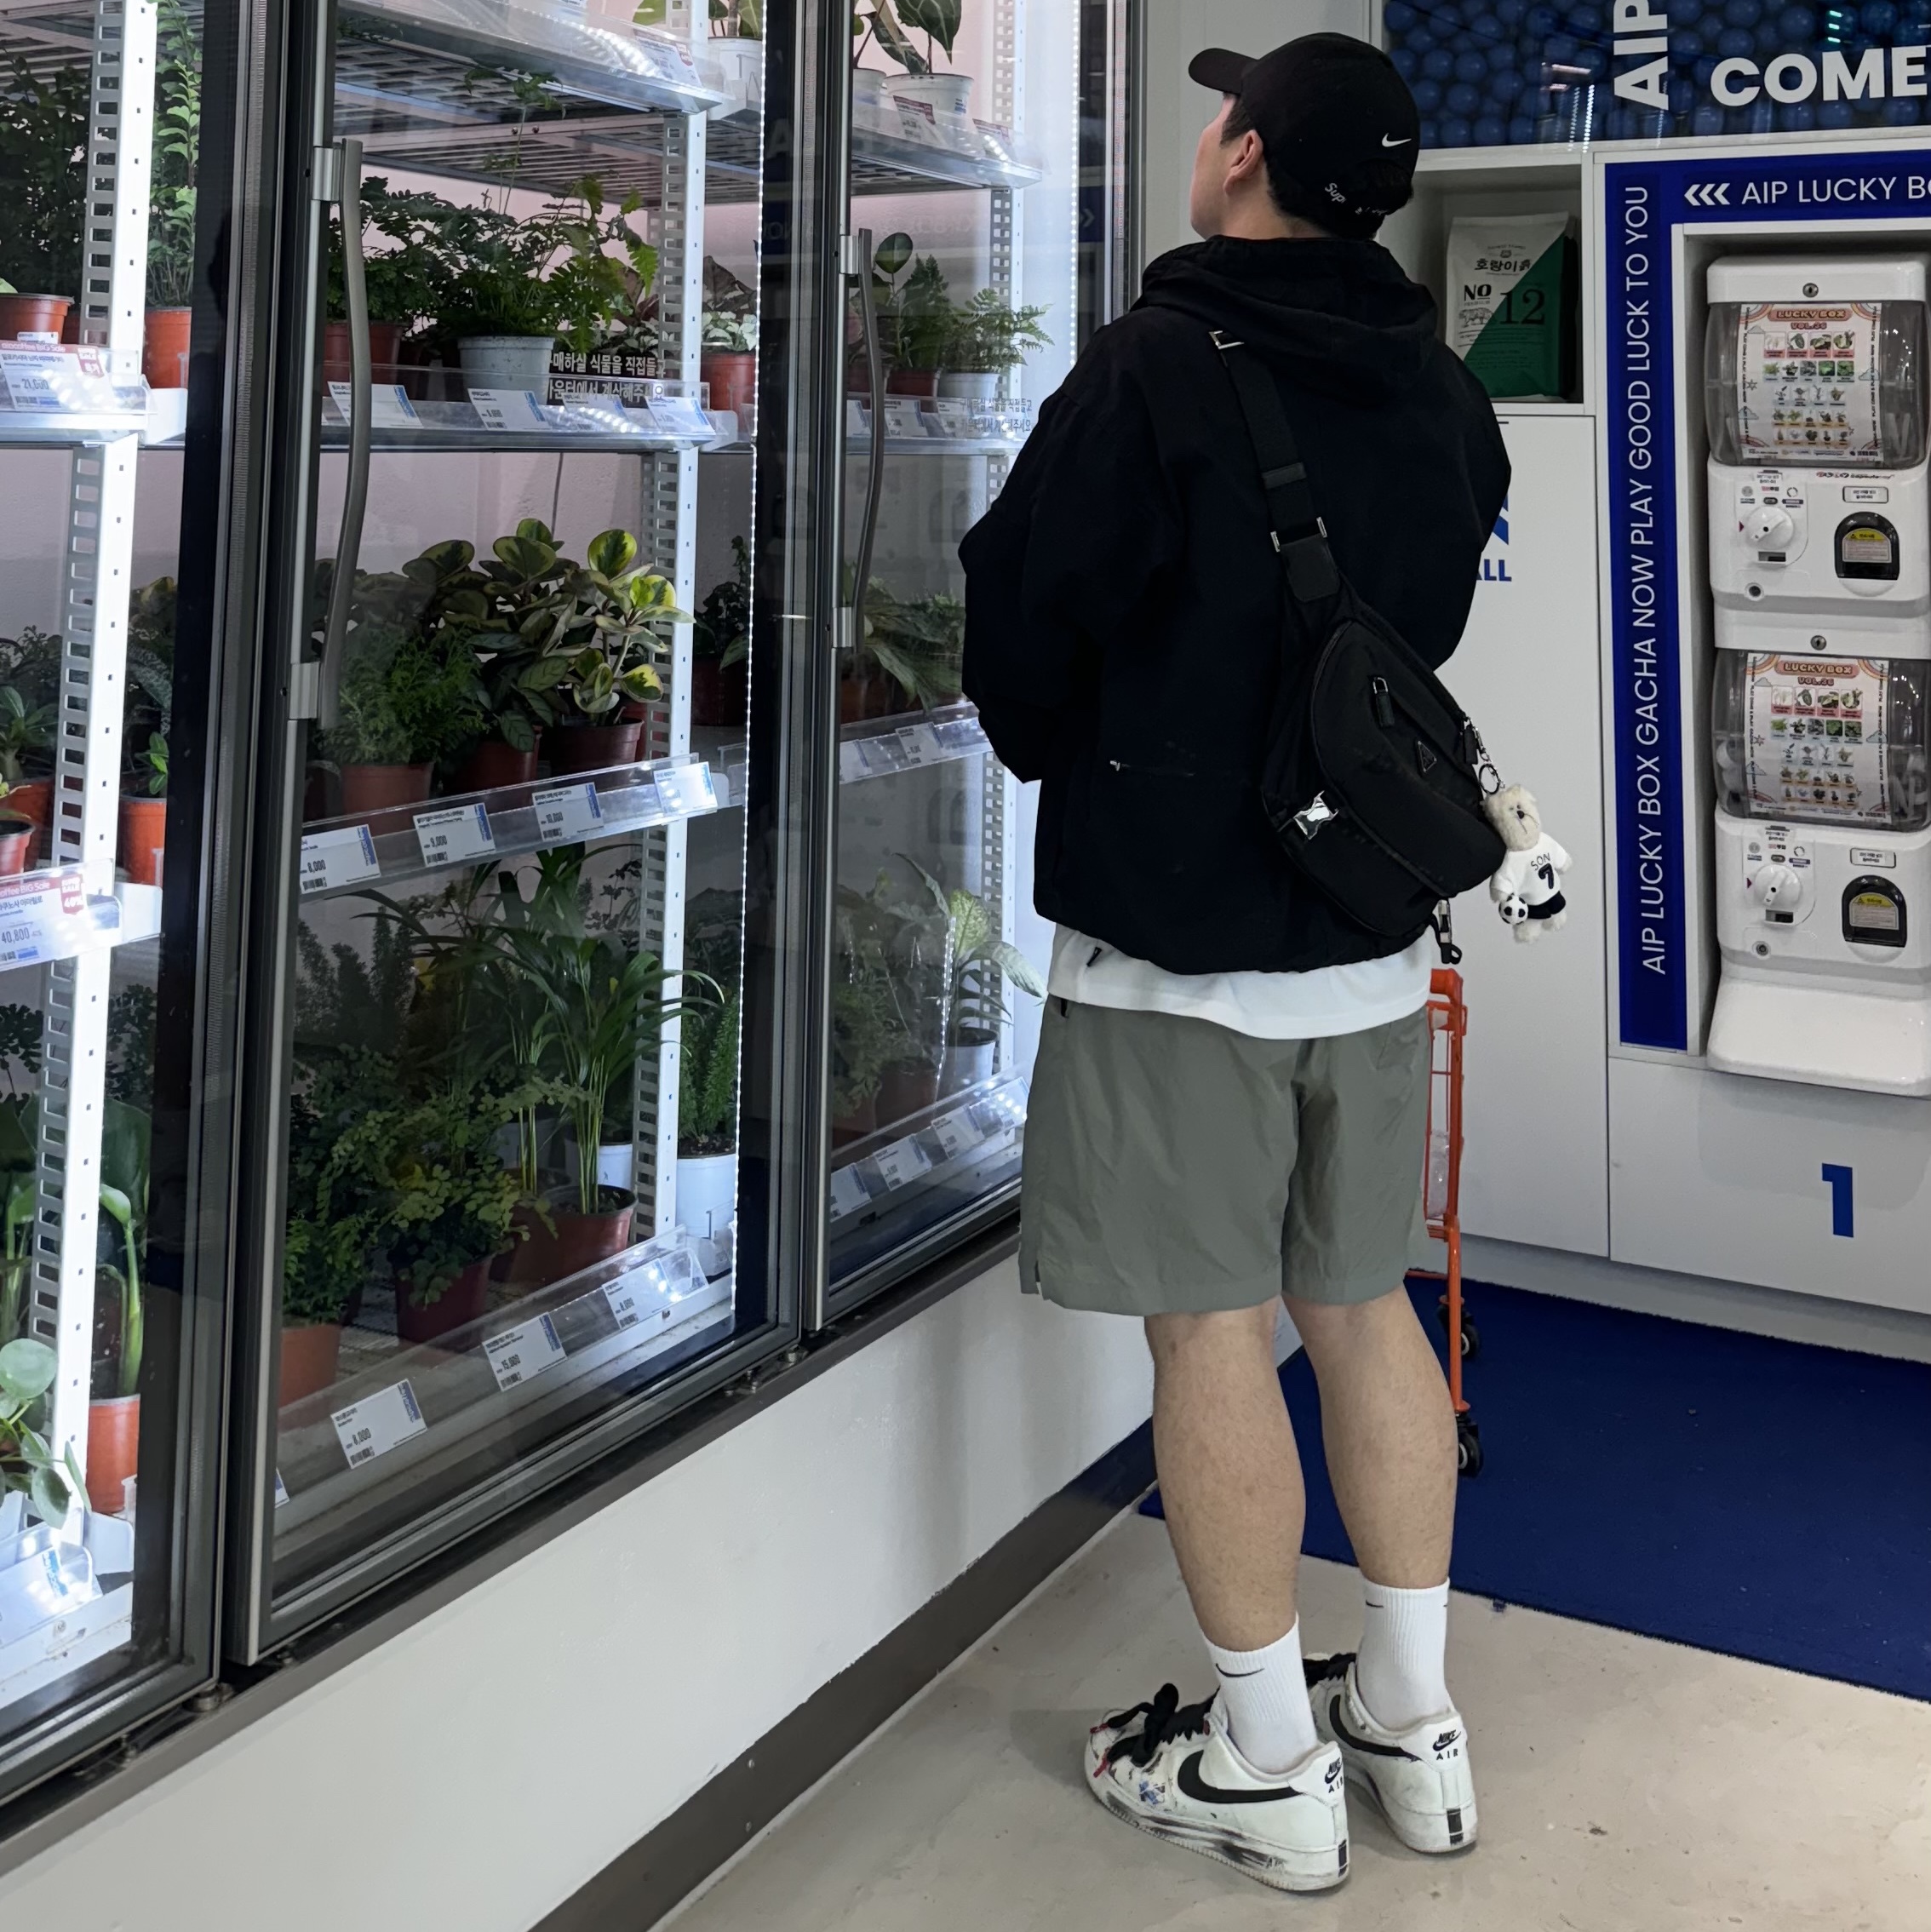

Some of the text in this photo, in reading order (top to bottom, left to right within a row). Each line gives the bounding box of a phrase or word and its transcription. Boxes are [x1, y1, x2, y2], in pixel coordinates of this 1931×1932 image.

[1613, 0, 1669, 110] AIP
[1741, 175, 1931, 204] AIP LUCKY B
[1499, 289, 1546, 324] 12
[1777, 310, 1846, 319] LUCKY BOX
[590, 353, 622, 375] 식물을
[625, 356, 666, 378] 직접들고
[1475, 559, 1512, 582] LL
[1625, 186, 1666, 975] AIP LUCKY BOX GACHA NOW PLAY GOOD LUCK TO YOU
[1784, 662, 1853, 674] LUCKY BOX
[1530, 852, 1551, 871] SON
[1538, 863, 1555, 889] 7
[1822, 1163, 1854, 1238] 1
[1437, 1729, 1457, 1744] NIKE
[1436, 1748, 1458, 1761] AIR
